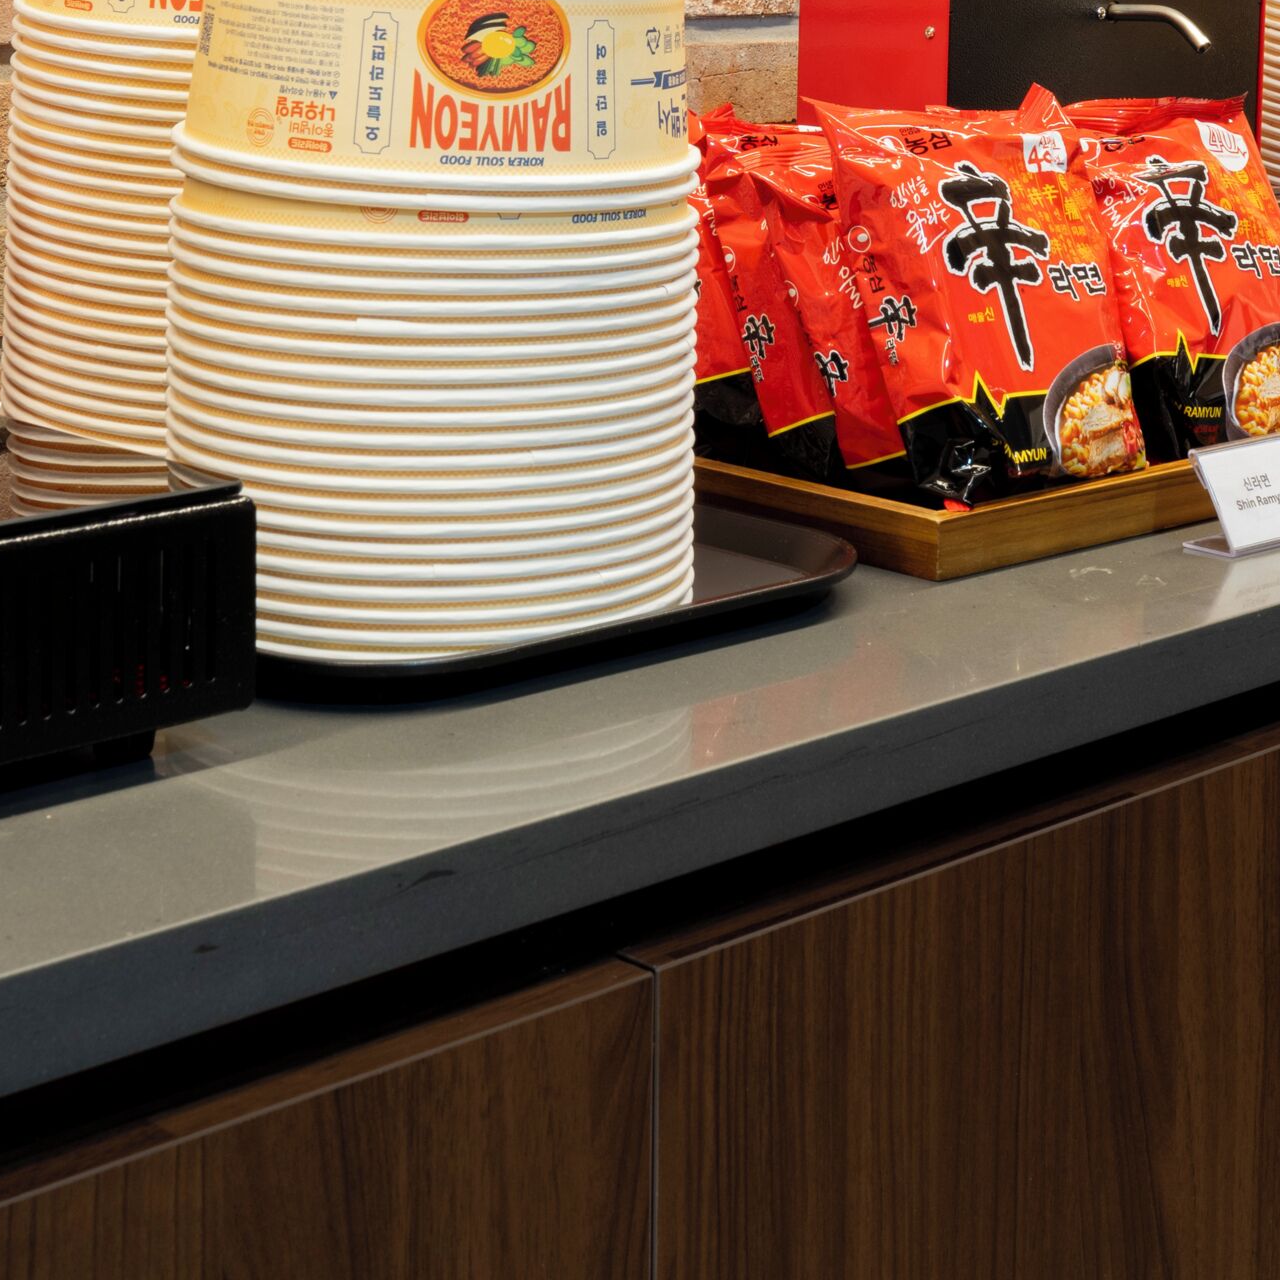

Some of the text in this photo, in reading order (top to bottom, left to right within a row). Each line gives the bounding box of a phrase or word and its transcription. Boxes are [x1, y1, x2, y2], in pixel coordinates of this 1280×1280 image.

[275, 96, 335, 121] 나우보일
[409, 68, 571, 153] RAMYEON
[289, 121, 334, 138] 종이냄비
[905, 132, 952, 155] 농심
[440, 155, 545, 167] KOREA SOUL FOOD
[572, 208, 646, 224] KOREA SOUL FOOD
[1144, 156, 1239, 337] 辛
[939, 161, 1051, 373] 辛
[1048, 262, 1107, 302] 라면
[968, 306, 995, 323] 매울신
[1184, 406, 1222, 418] RAMYUN
[1243, 473, 1272, 491] 신라면
[1236, 499, 1257, 511] Shin
